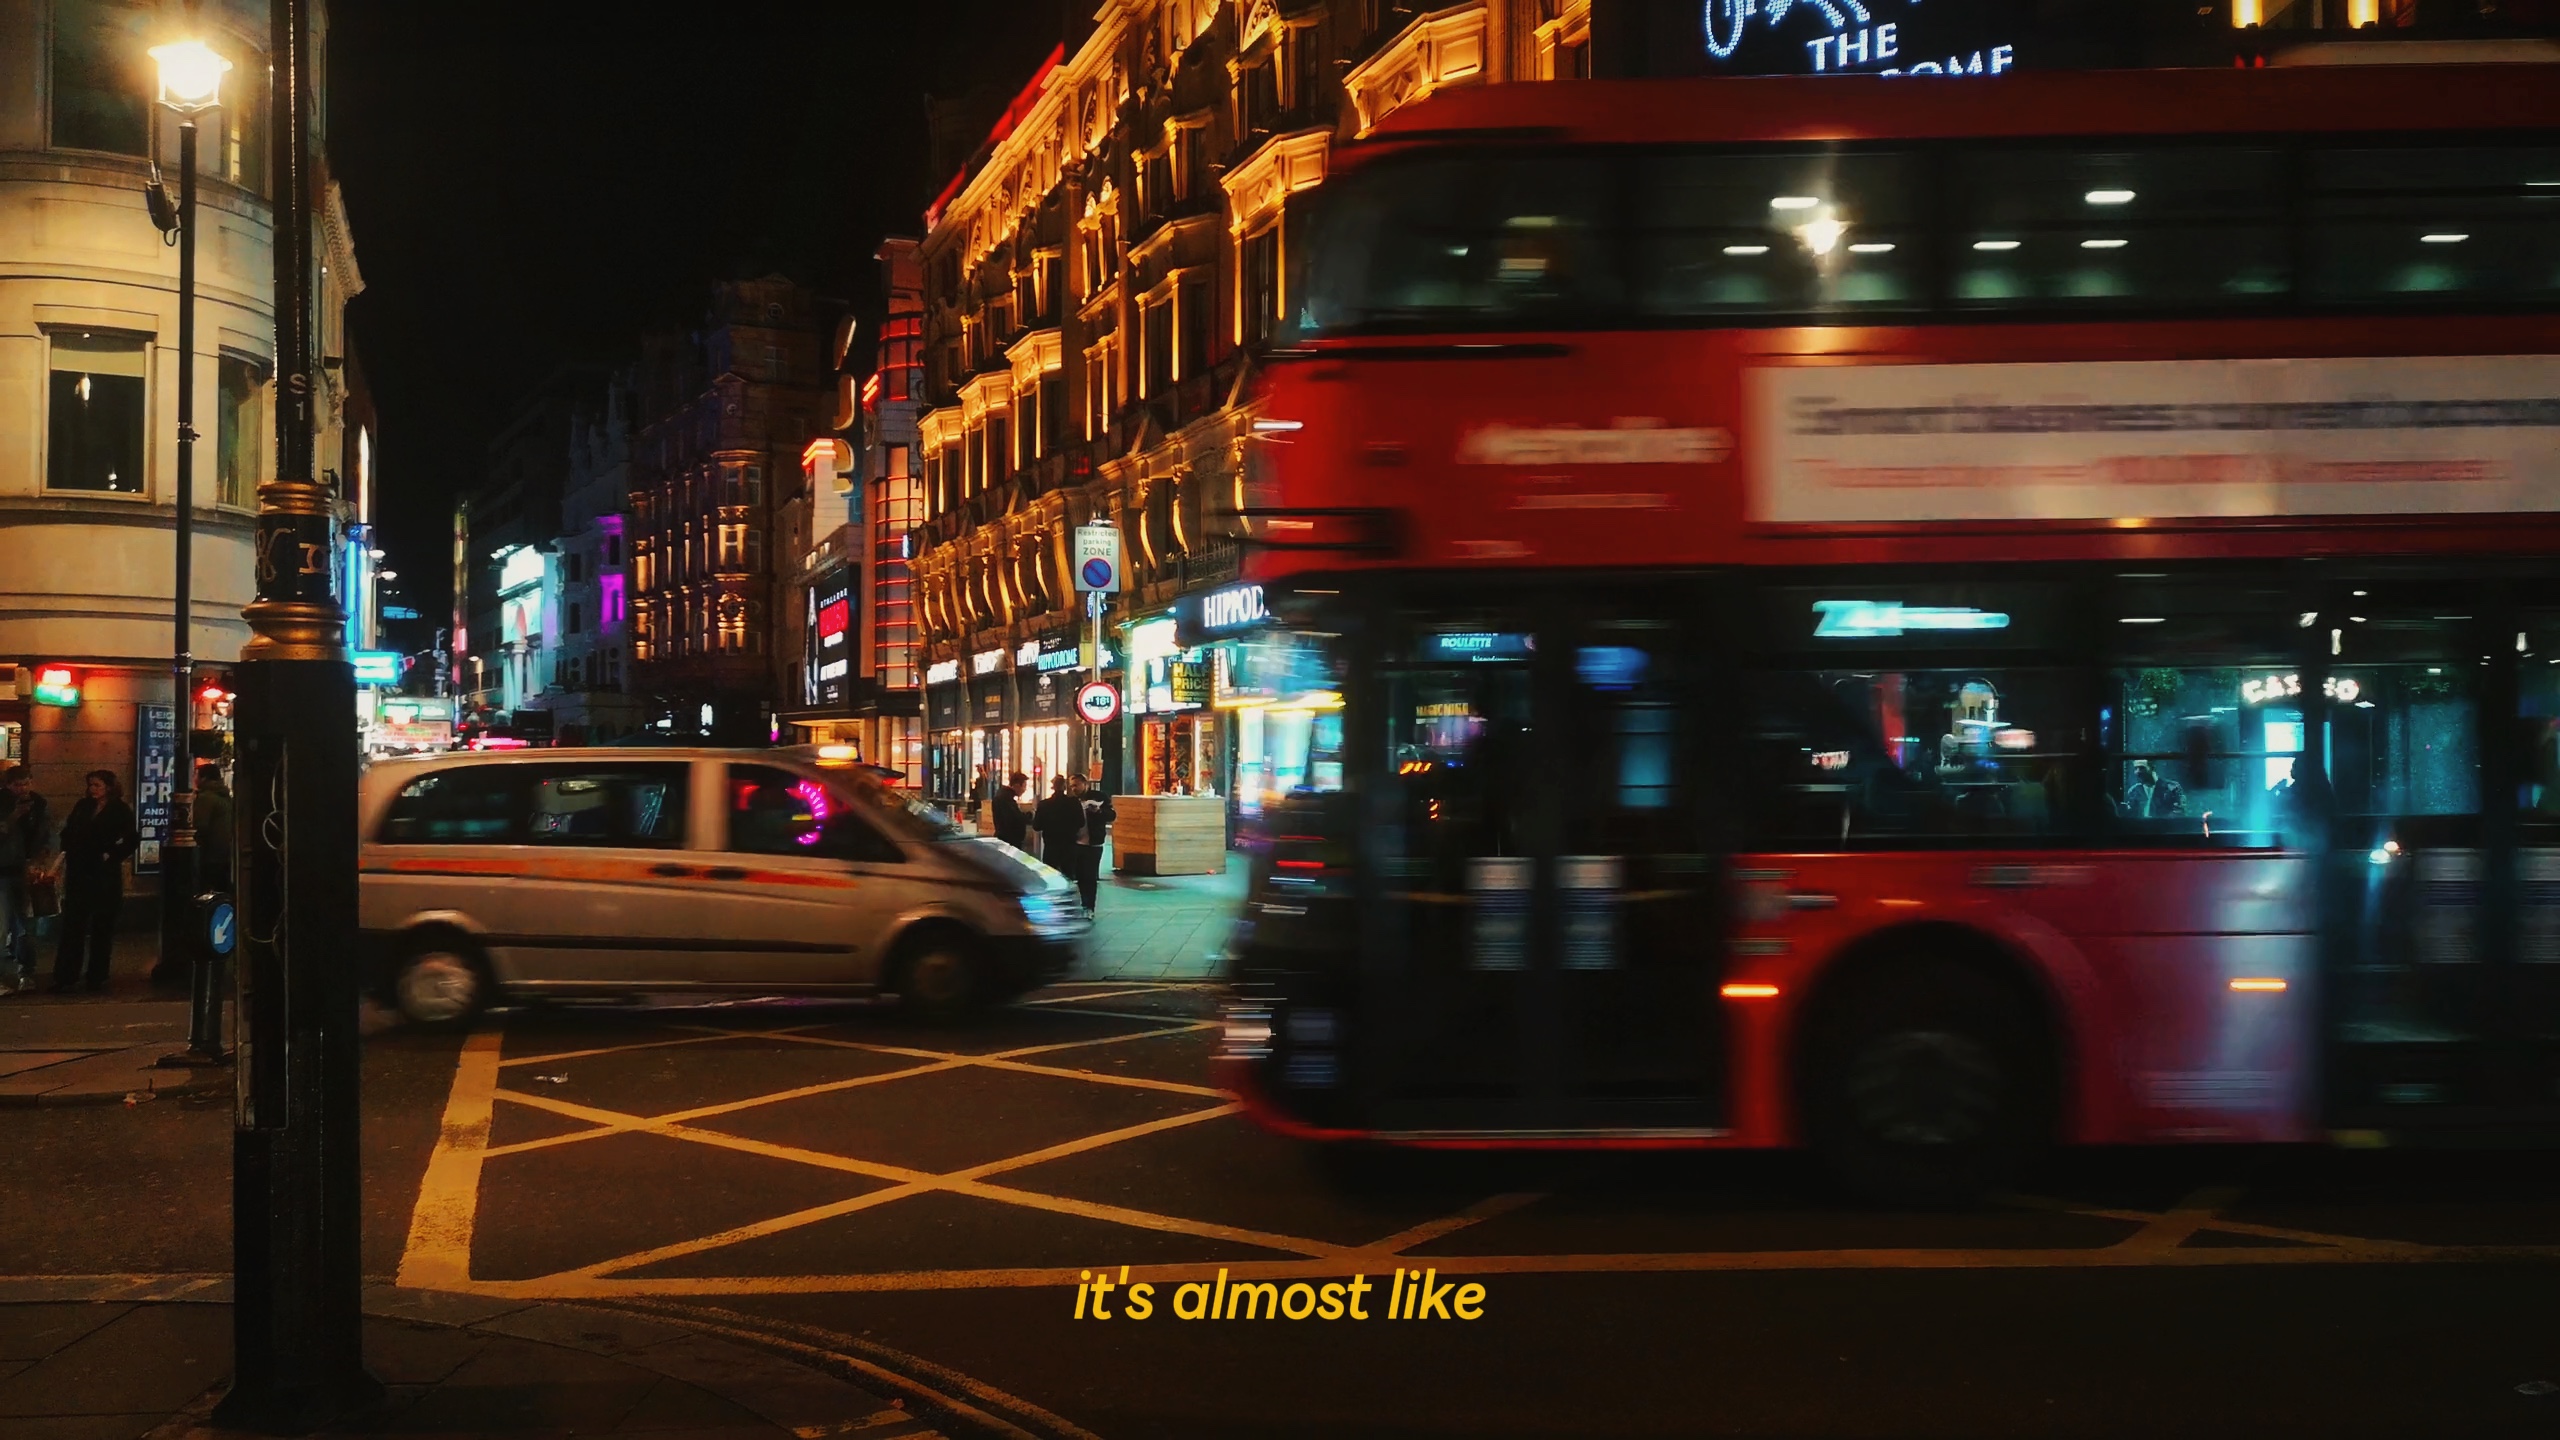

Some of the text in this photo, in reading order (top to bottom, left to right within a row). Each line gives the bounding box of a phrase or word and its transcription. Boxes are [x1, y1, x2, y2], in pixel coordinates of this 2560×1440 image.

[1806, 22, 1898, 72] THE
[1077, 529, 1118, 537] Restricted
[1083, 547, 1112, 556] ZONE
[1204, 585, 1270, 628] HIPPOD
[1441, 637, 1492, 648] ROULETTE
[1173, 677, 1210, 690] PRICE
[144, 807, 164, 816] AND
